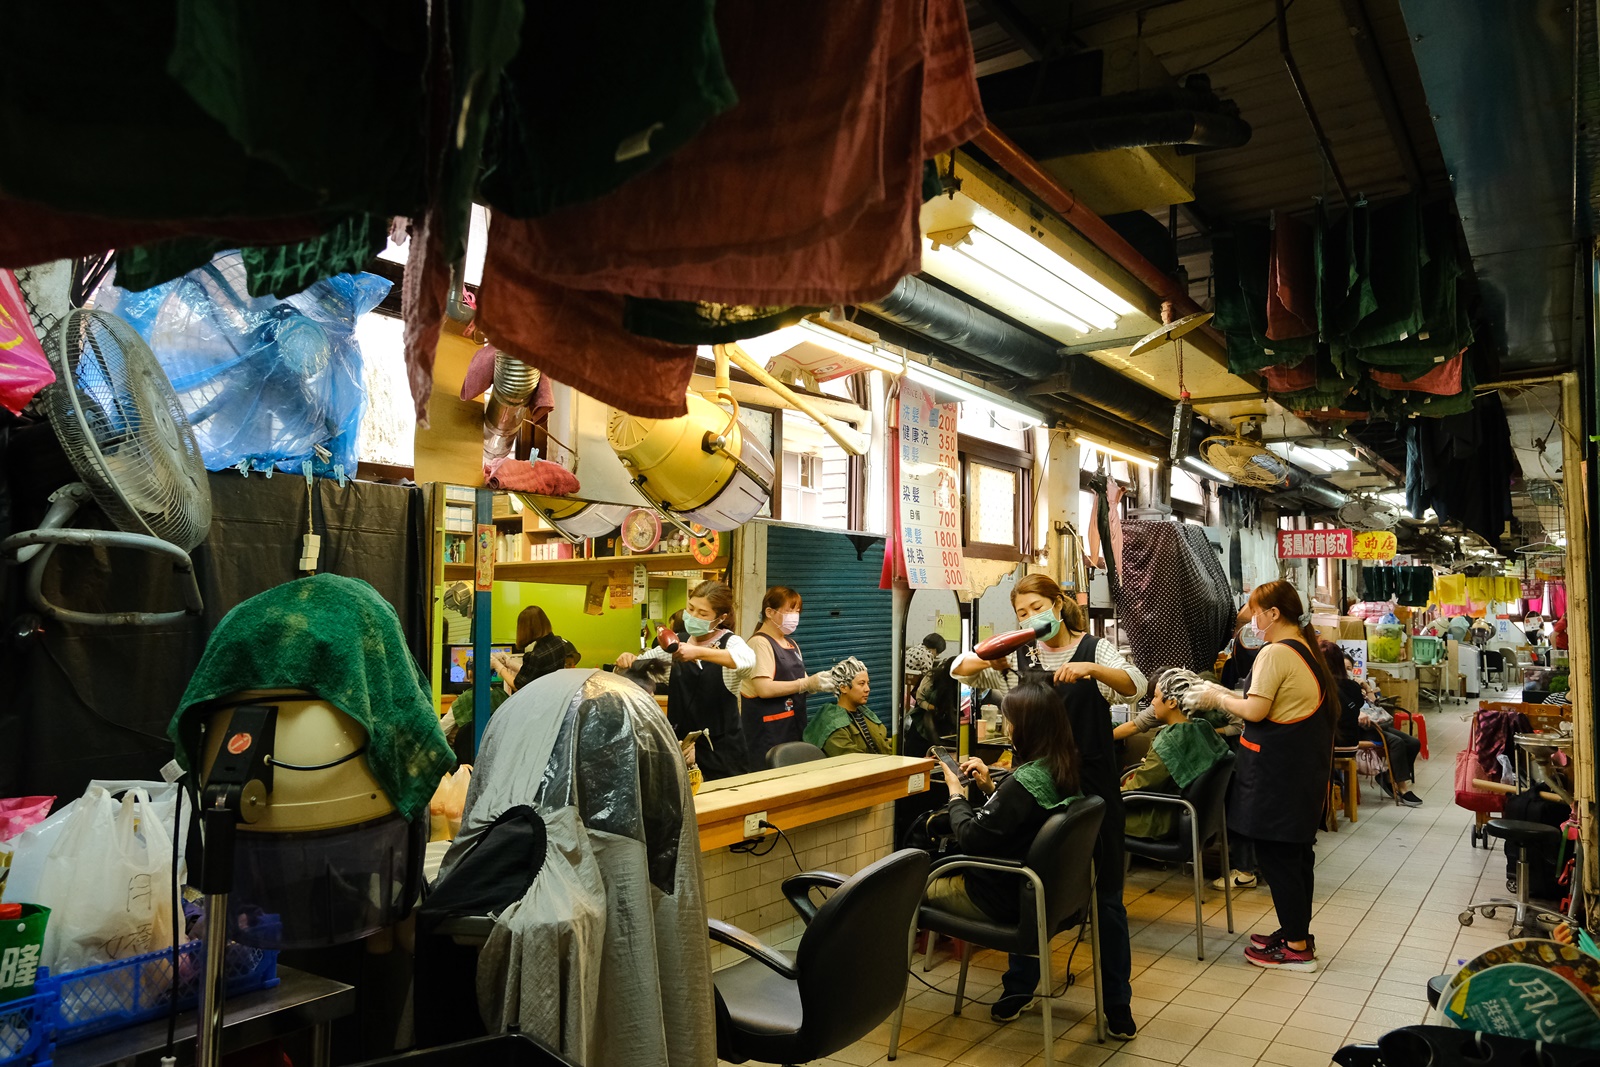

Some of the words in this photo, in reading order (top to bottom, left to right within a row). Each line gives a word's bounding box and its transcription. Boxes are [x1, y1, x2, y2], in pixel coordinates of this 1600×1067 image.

[902, 404, 920, 424] 洗髮
[938, 413, 956, 434] 200
[902, 424, 929, 446] 健康洗
[938, 433, 956, 453] 350
[902, 444, 920, 463] 剪髮
[902, 485, 920, 504] 染髮
[938, 511, 956, 528] 700
[904, 527, 922, 545] 燙髮
[934, 530, 958, 549] 1800
[1282, 532, 1348, 556] 秀鳳服飾修改
[906, 548, 925, 565] 挑染
[942, 550, 960, 568] 800
[944, 568, 963, 586] 300
[0, 943, 41, 990] 隆
